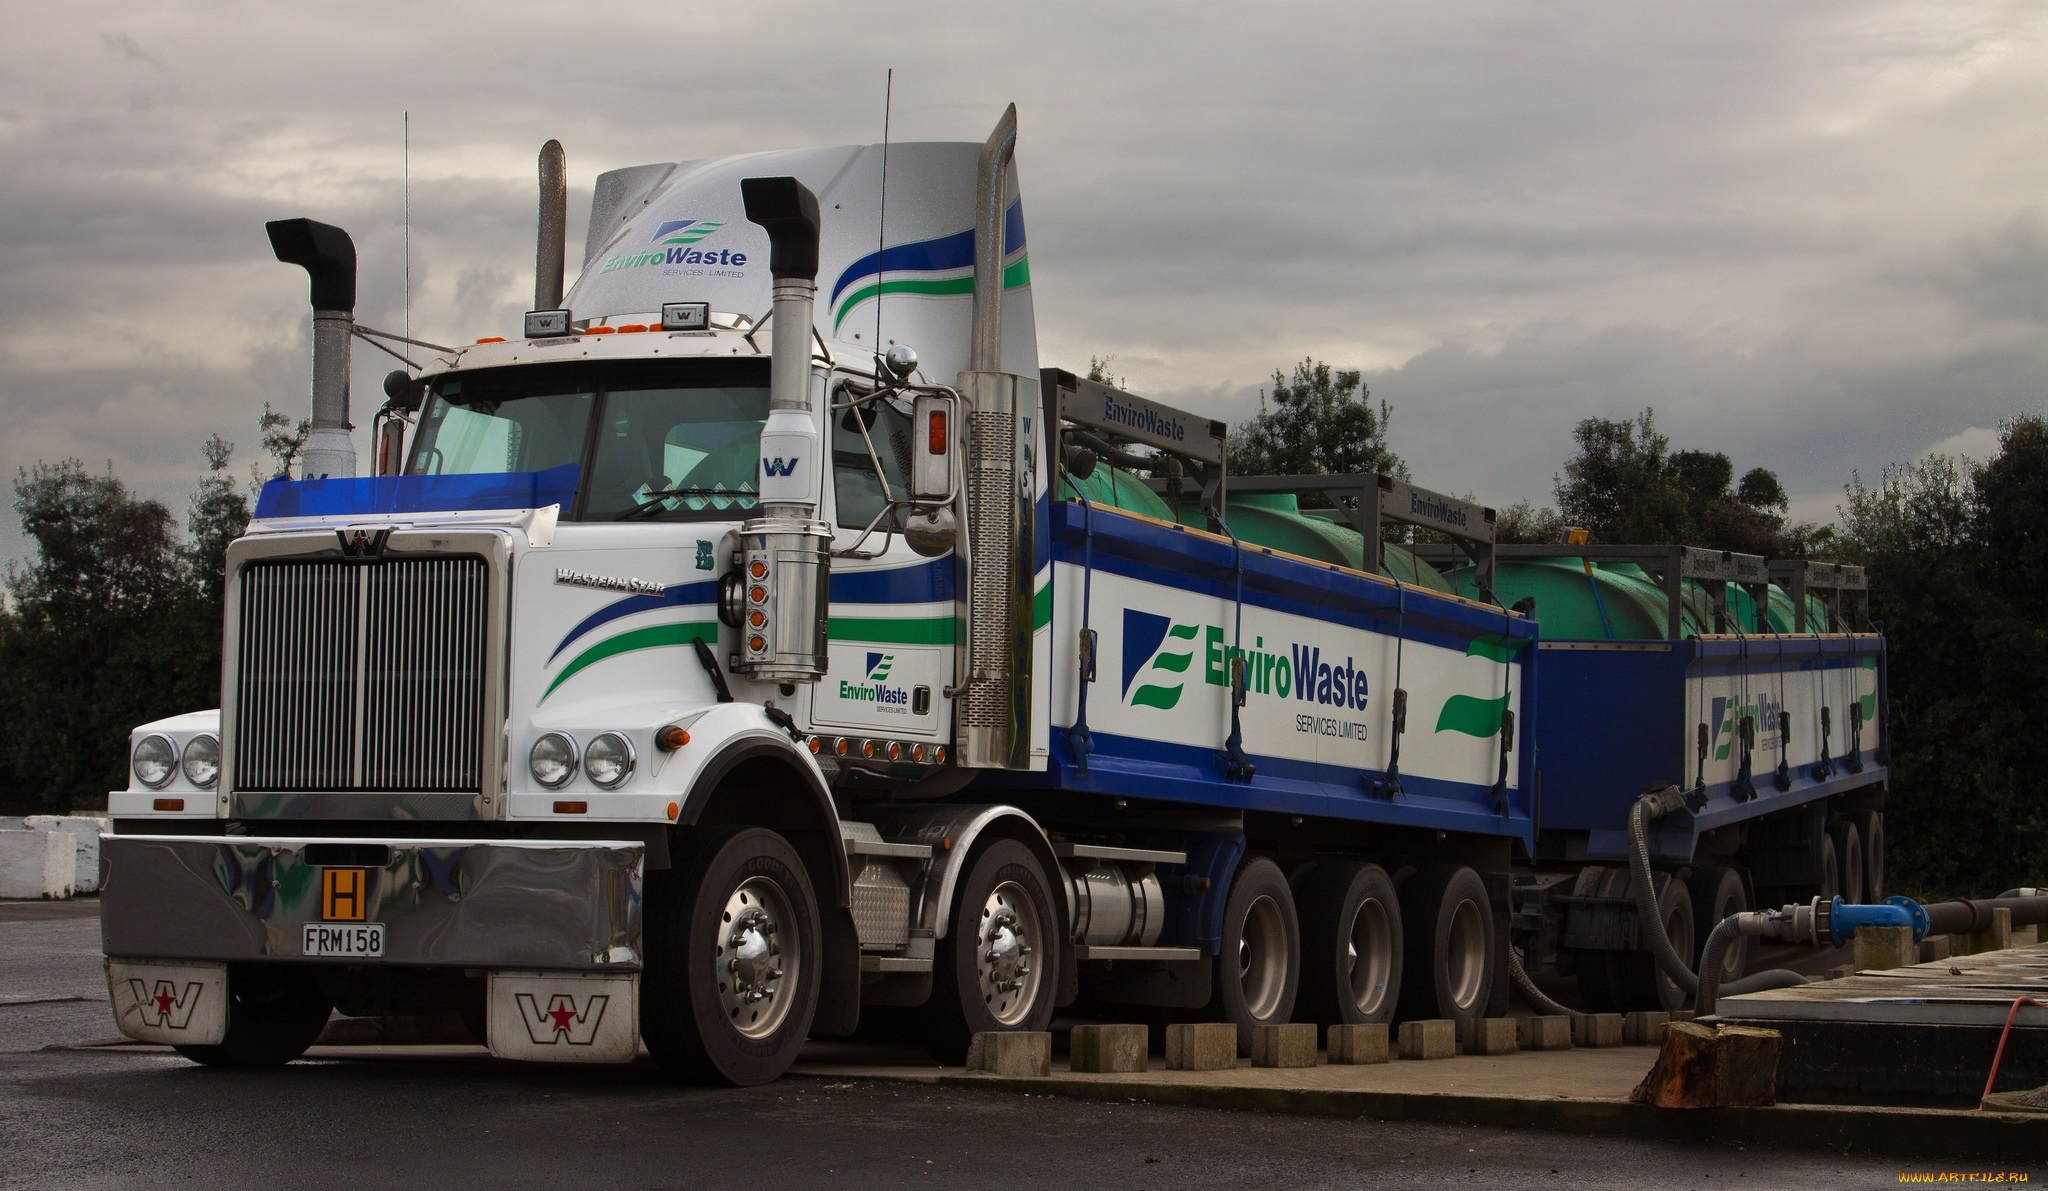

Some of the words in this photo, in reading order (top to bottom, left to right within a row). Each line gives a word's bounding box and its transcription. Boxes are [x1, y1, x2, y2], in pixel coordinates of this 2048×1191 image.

[600, 247, 747, 275] EnviroWaste
[662, 269, 704, 277] SERVICES
[709, 270, 745, 279] LIMITED
[1104, 395, 1184, 441] EnviroWaste
[1411, 492, 1467, 527] EnviroWaste
[555, 568, 628, 592] WESTERN
[628, 577, 666, 597] STAR
[839, 680, 908, 705] EnviroWaste
[1296, 713, 1337, 737] SERVICES
[1338, 722, 1368, 741] LIMITED
[330, 871, 358, 918] H
[305, 928, 380, 952] FRM158
